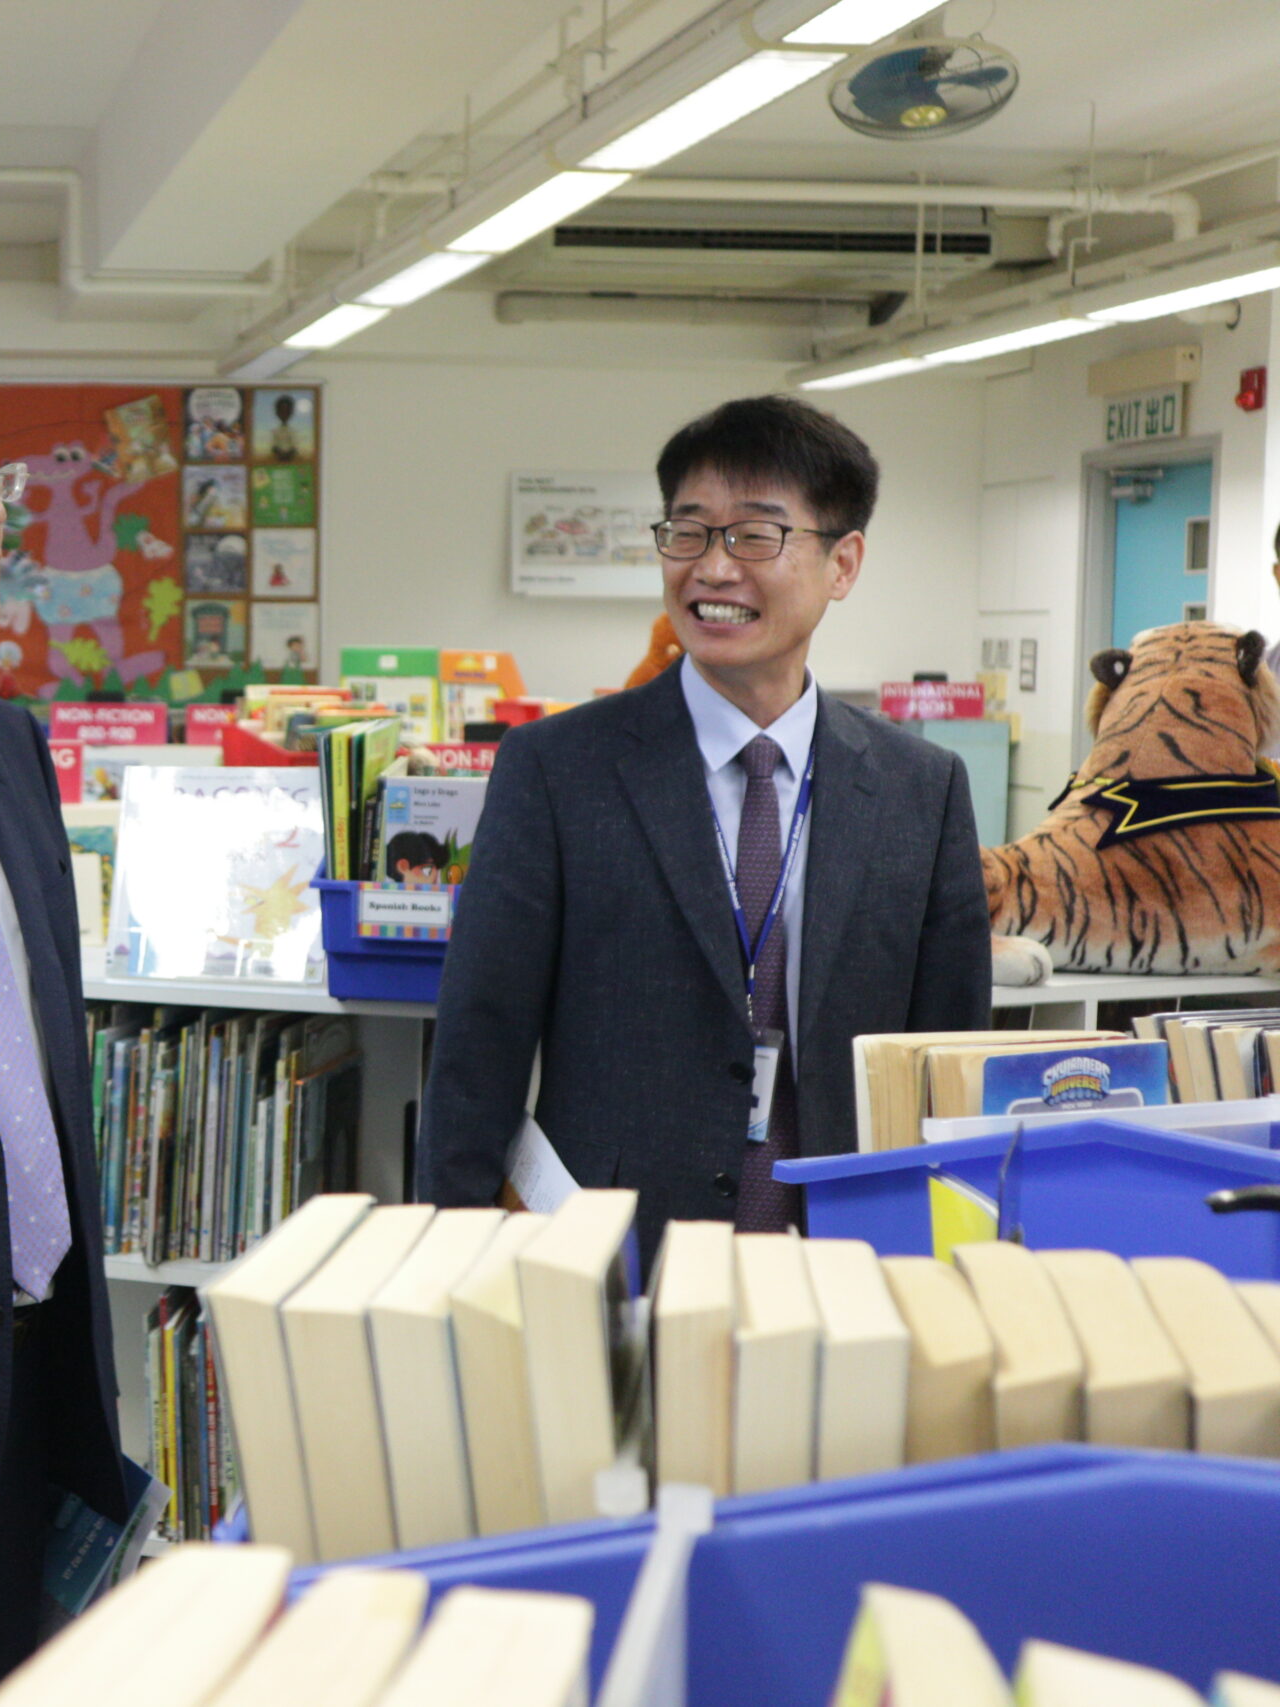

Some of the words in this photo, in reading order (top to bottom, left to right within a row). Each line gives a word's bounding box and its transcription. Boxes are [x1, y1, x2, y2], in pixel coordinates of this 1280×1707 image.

[1107, 401, 1141, 441] EXIT
[1145, 394, 1176, 435] 出口
[883, 684, 981, 698] INTERNATIONAL
[909, 700, 955, 714] BOOKS
[58, 708, 154, 723] NON-FICTION
[369, 901, 408, 912] Spanish
[411, 903, 442, 913] Books
